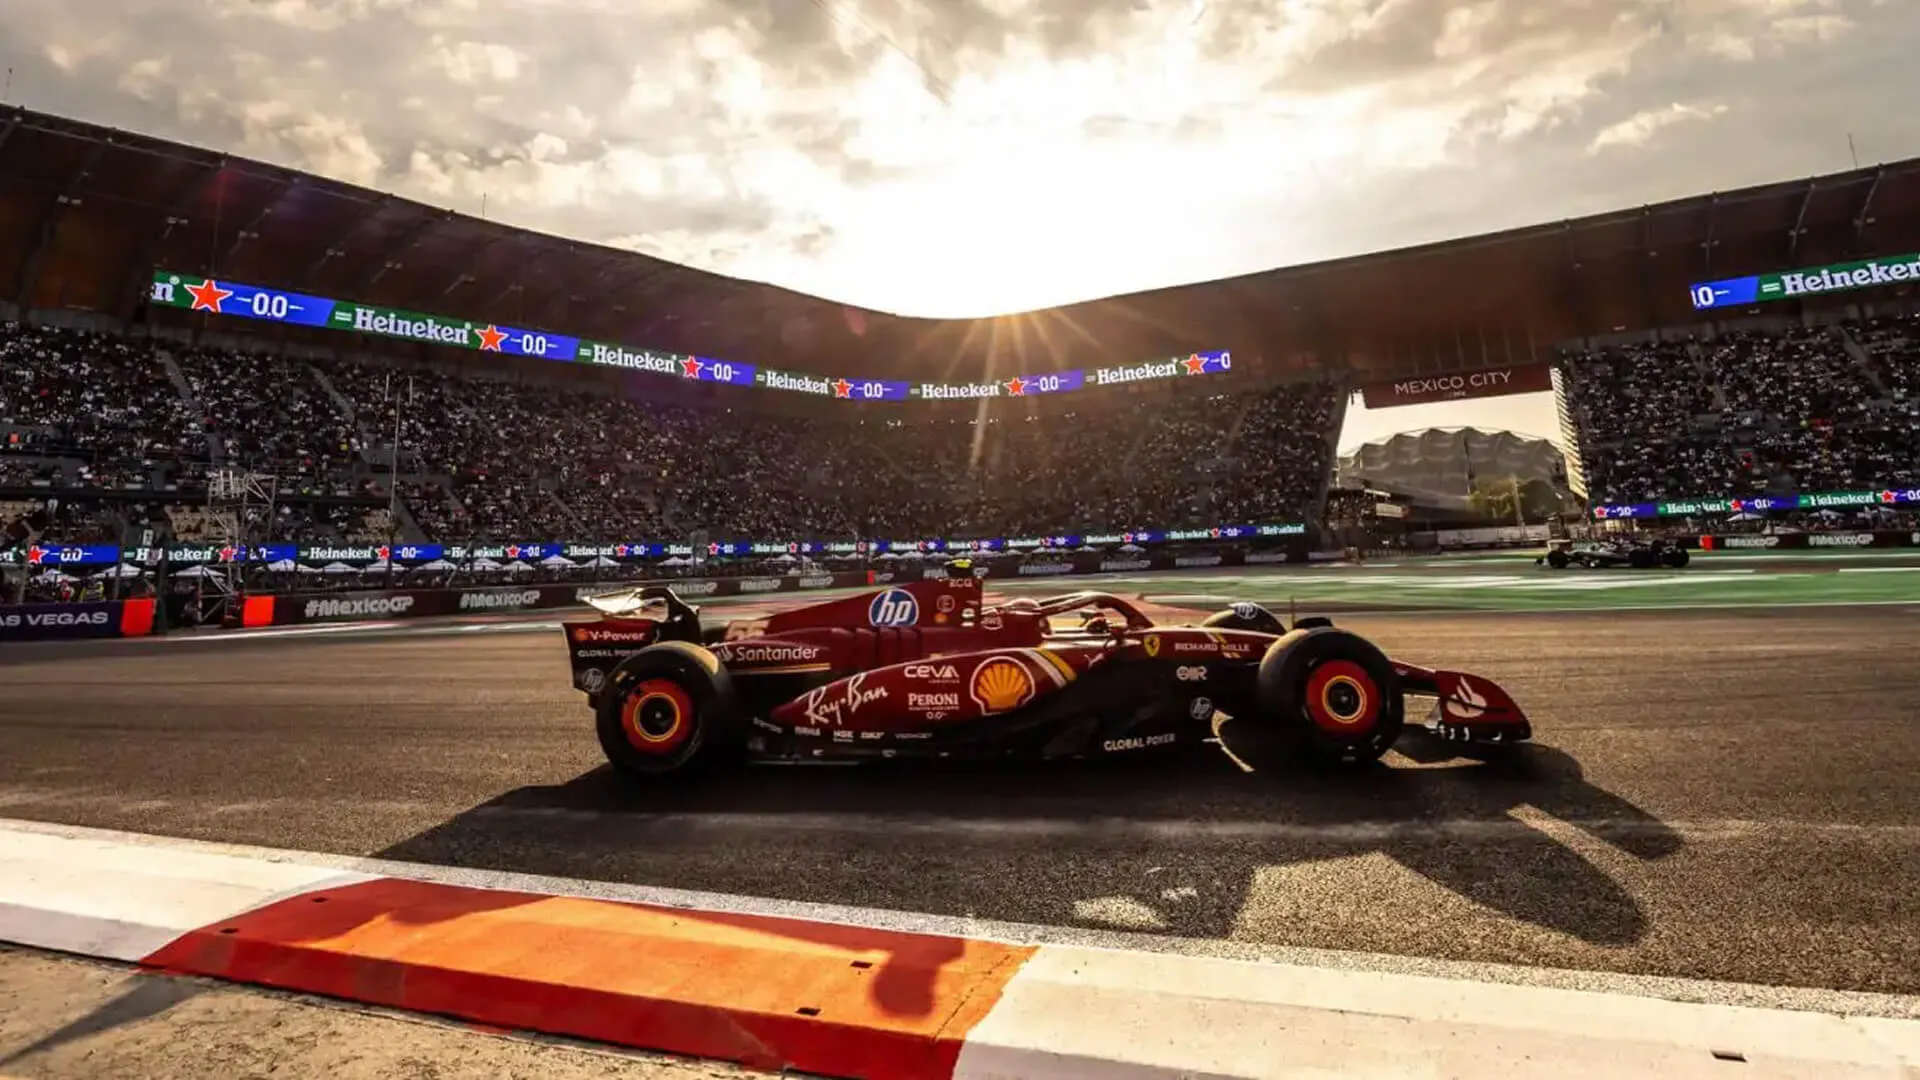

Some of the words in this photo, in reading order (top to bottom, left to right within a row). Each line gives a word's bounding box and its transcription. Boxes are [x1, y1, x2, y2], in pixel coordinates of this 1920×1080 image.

[355, 308, 469, 345] Heineken
[593, 344, 676, 374] Heineken
[766, 371, 829, 394] Heineken
[922, 383, 1000, 399] Heineken
[1097, 362, 1177, 385] Heineken
[1394, 376, 1464, 395] MEXICO
[1470, 370, 1513, 388] CITY
[309, 547, 372, 560] Heineken
[305, 595, 414, 618] #MexicoGP
[460, 590, 541, 609] #MexicoGP
[875, 590, 912, 627] hp
[26, 612, 109, 626] VEGAS
[588, 630, 646, 641] V-Power
[736, 646, 819, 661] Santander
[803, 671, 890, 726] Ray-Ban
[907, 692, 959, 706] PERONI
[1103, 737, 1146, 752] GLOBAL
